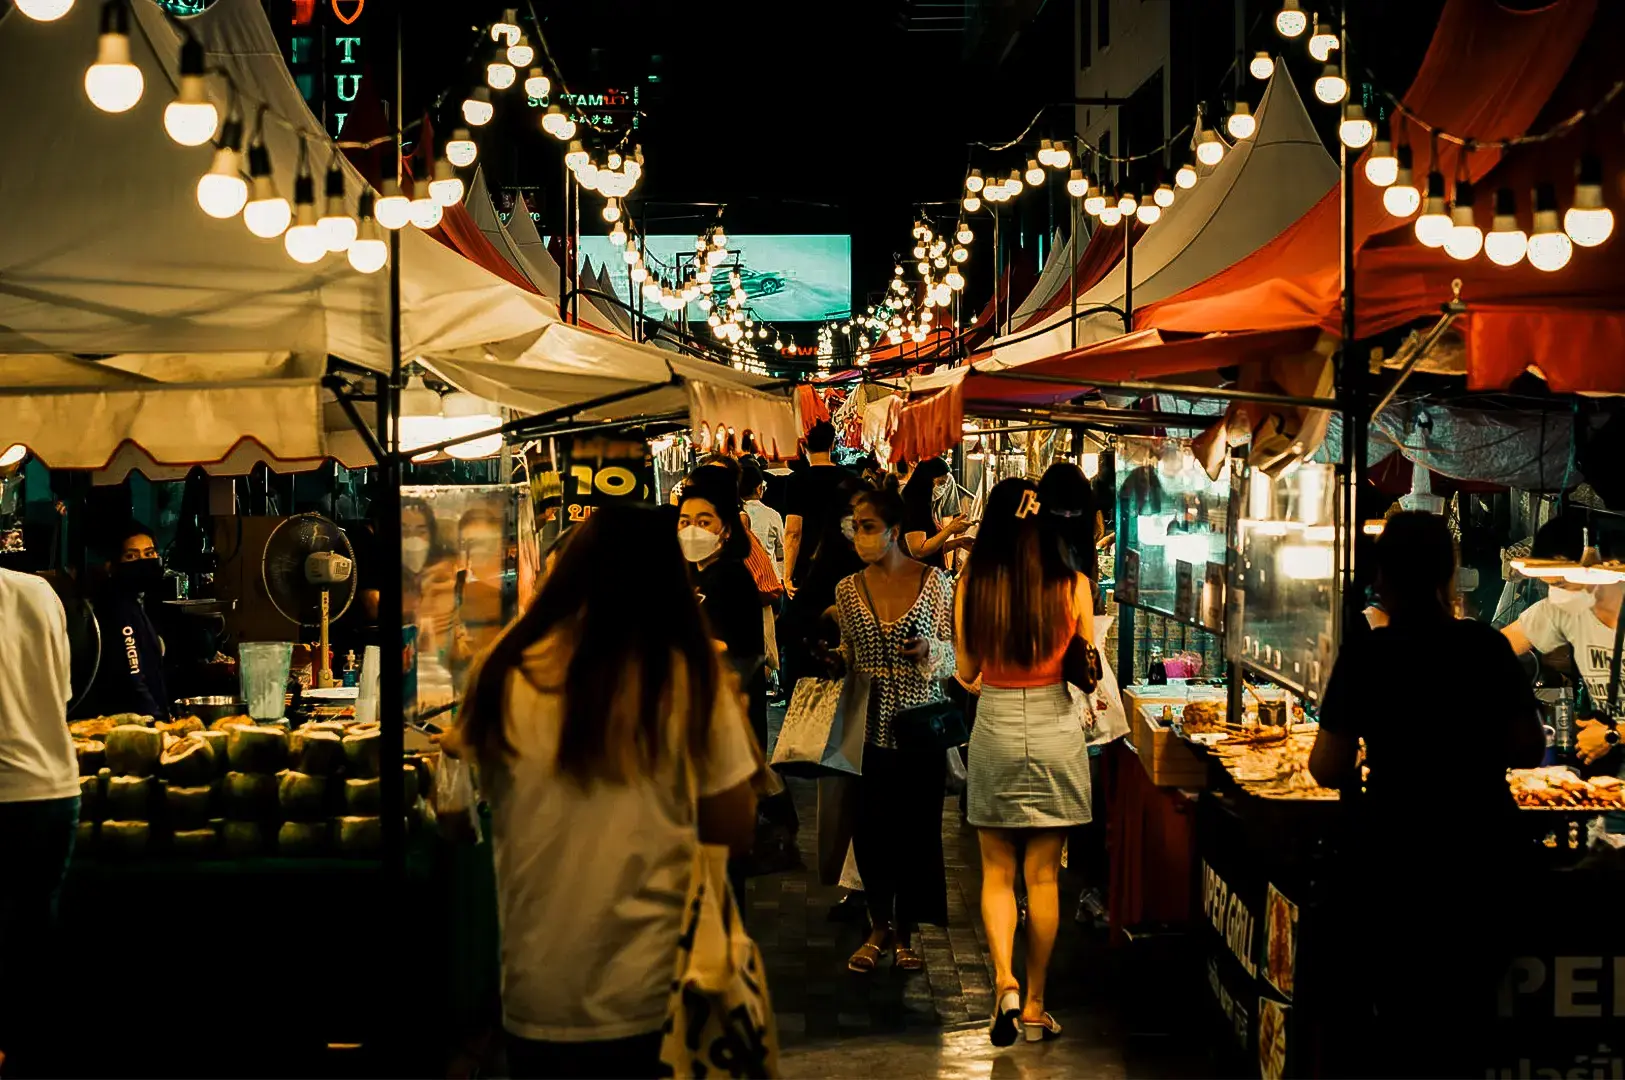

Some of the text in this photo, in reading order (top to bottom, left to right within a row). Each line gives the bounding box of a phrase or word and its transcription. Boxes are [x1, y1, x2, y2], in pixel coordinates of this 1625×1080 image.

[527, 94, 603, 107] SOTAM
[571, 465, 637, 496] 10
[1498, 956, 1625, 1018] PE
